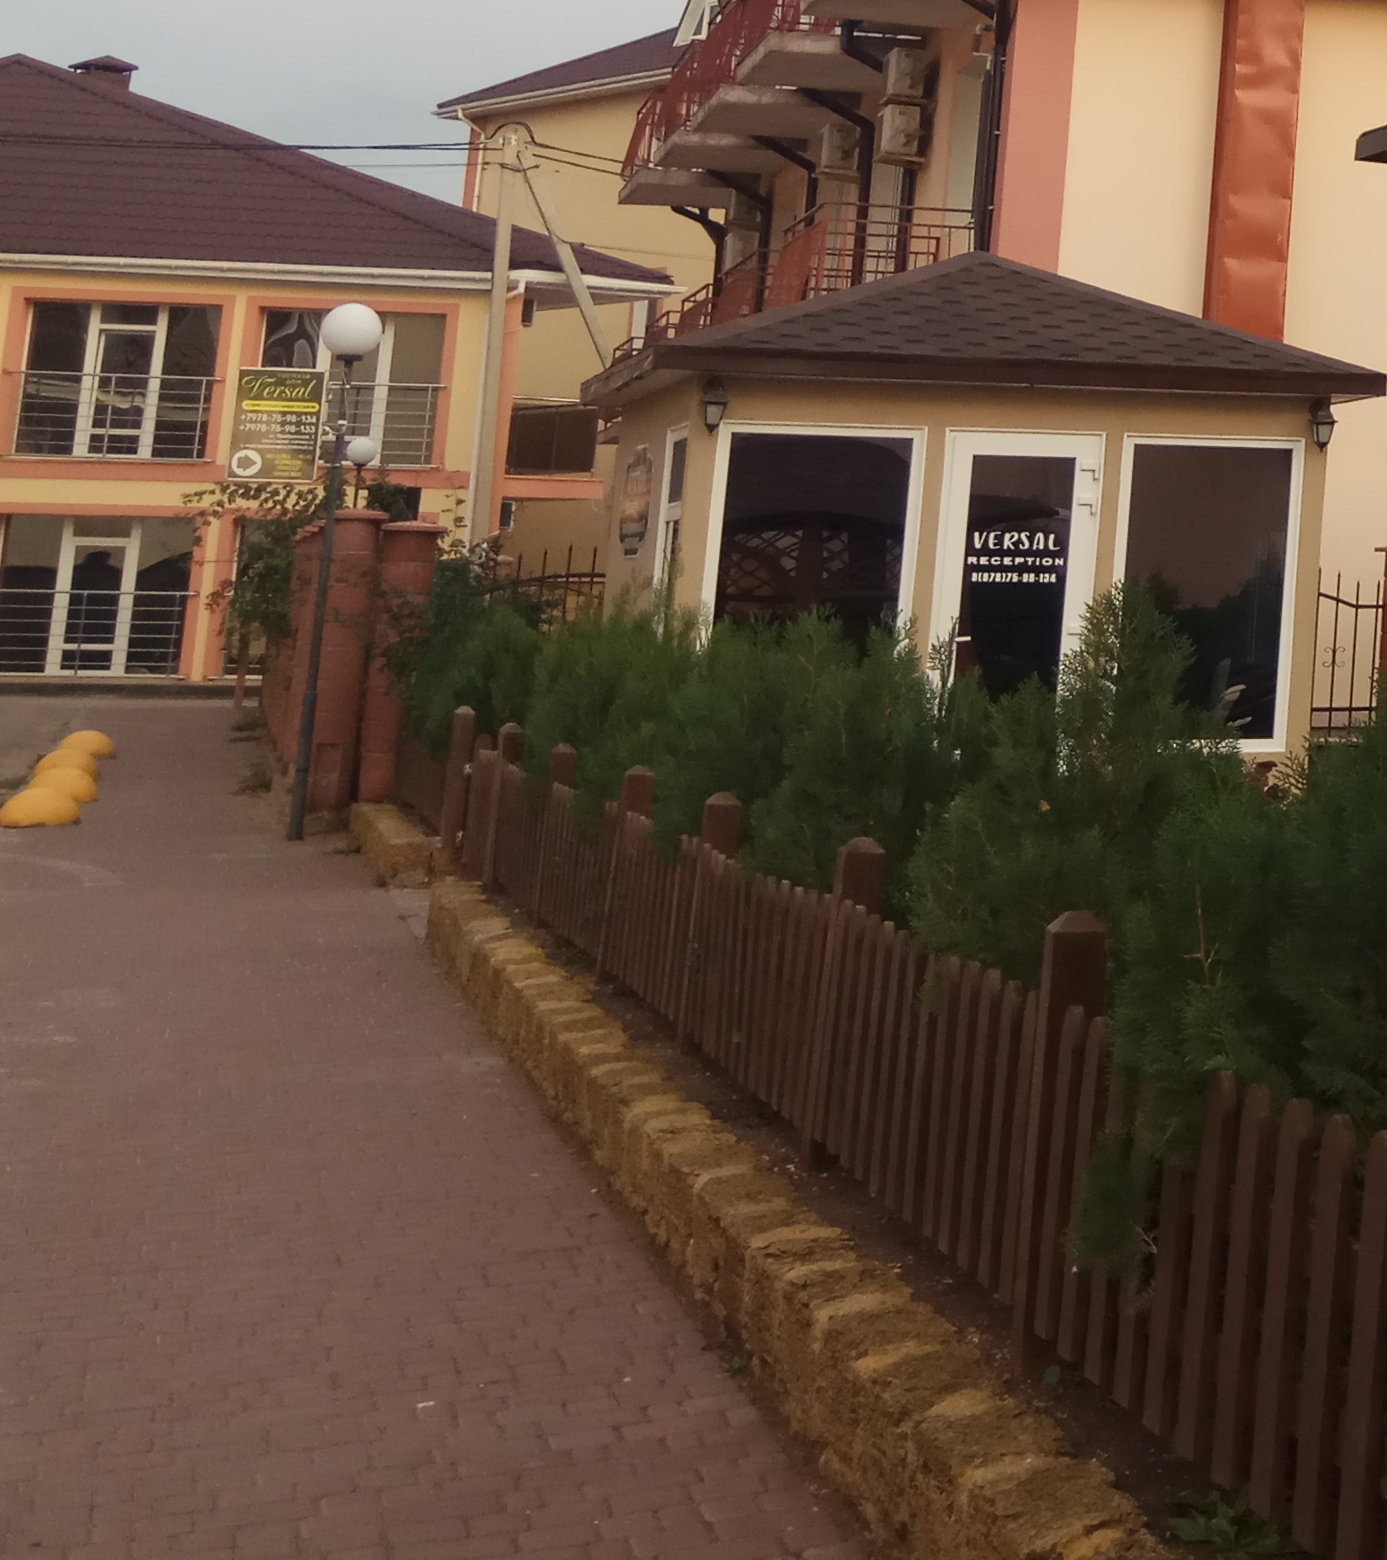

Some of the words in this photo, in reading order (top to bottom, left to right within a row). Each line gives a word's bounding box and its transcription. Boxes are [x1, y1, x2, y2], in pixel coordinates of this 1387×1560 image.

[241, 375, 317, 399] Versal
[973, 531, 1060, 551] VERSAL
[966, 556, 1064, 567] RECEPTION
